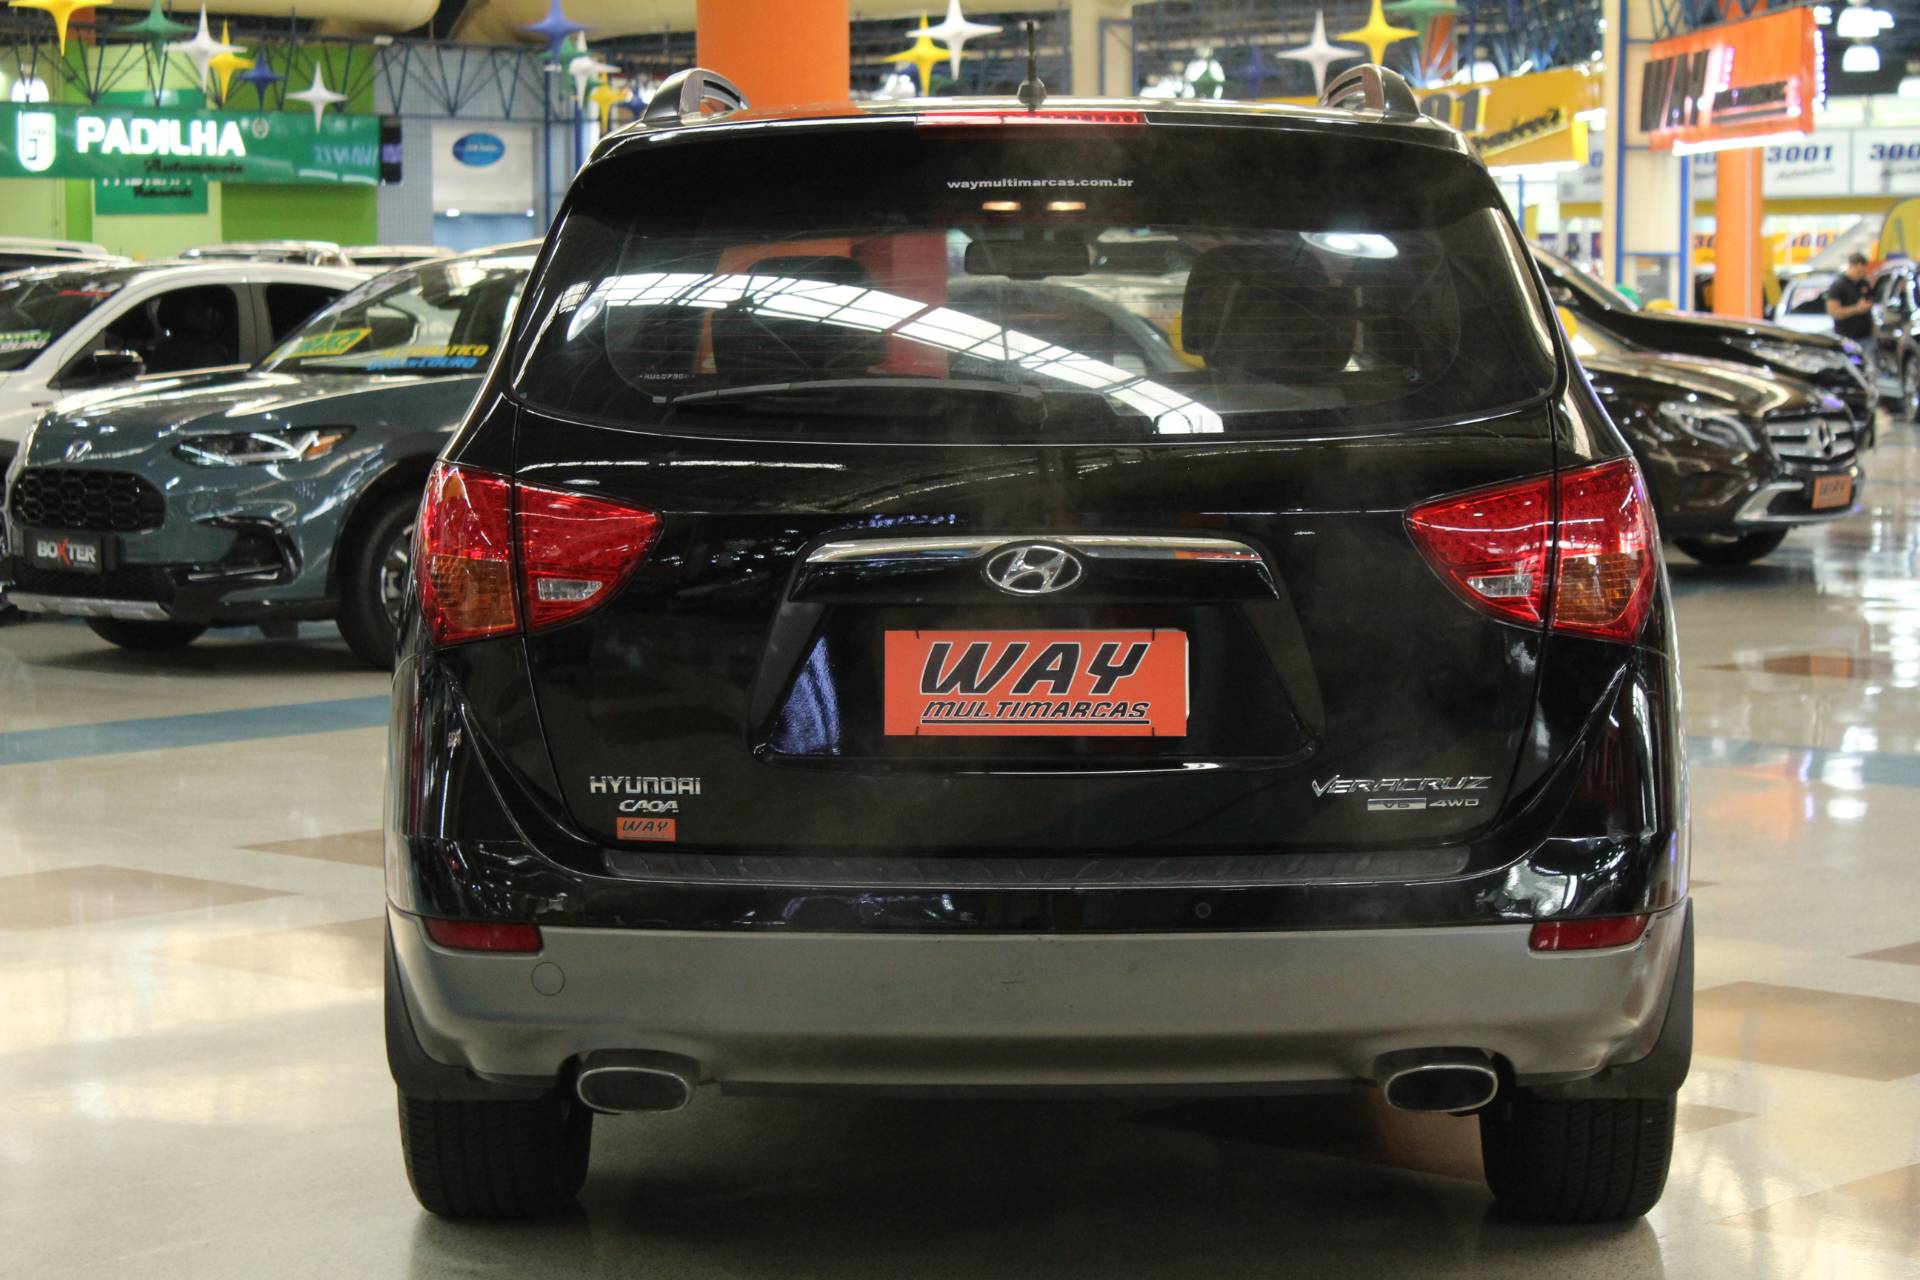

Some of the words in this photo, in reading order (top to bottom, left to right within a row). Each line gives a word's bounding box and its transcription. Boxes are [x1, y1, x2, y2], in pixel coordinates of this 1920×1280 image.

[76, 116, 247, 157] PADILHA
[1767, 144, 1834, 164] 3001
[947, 178, 1134, 190] waymultimarcas.com.br
[37, 537, 96, 567] BOXTER
[919, 641, 1151, 696] WAY
[922, 700, 1151, 719] MULTIMARCAS
[590, 776, 701, 795] HYUNDAI
[1312, 774, 1492, 797] VERACRUZ
[619, 799, 679, 813] CAOA
[1429, 798, 1480, 808] 4WD
[623, 820, 668, 832] WAY
